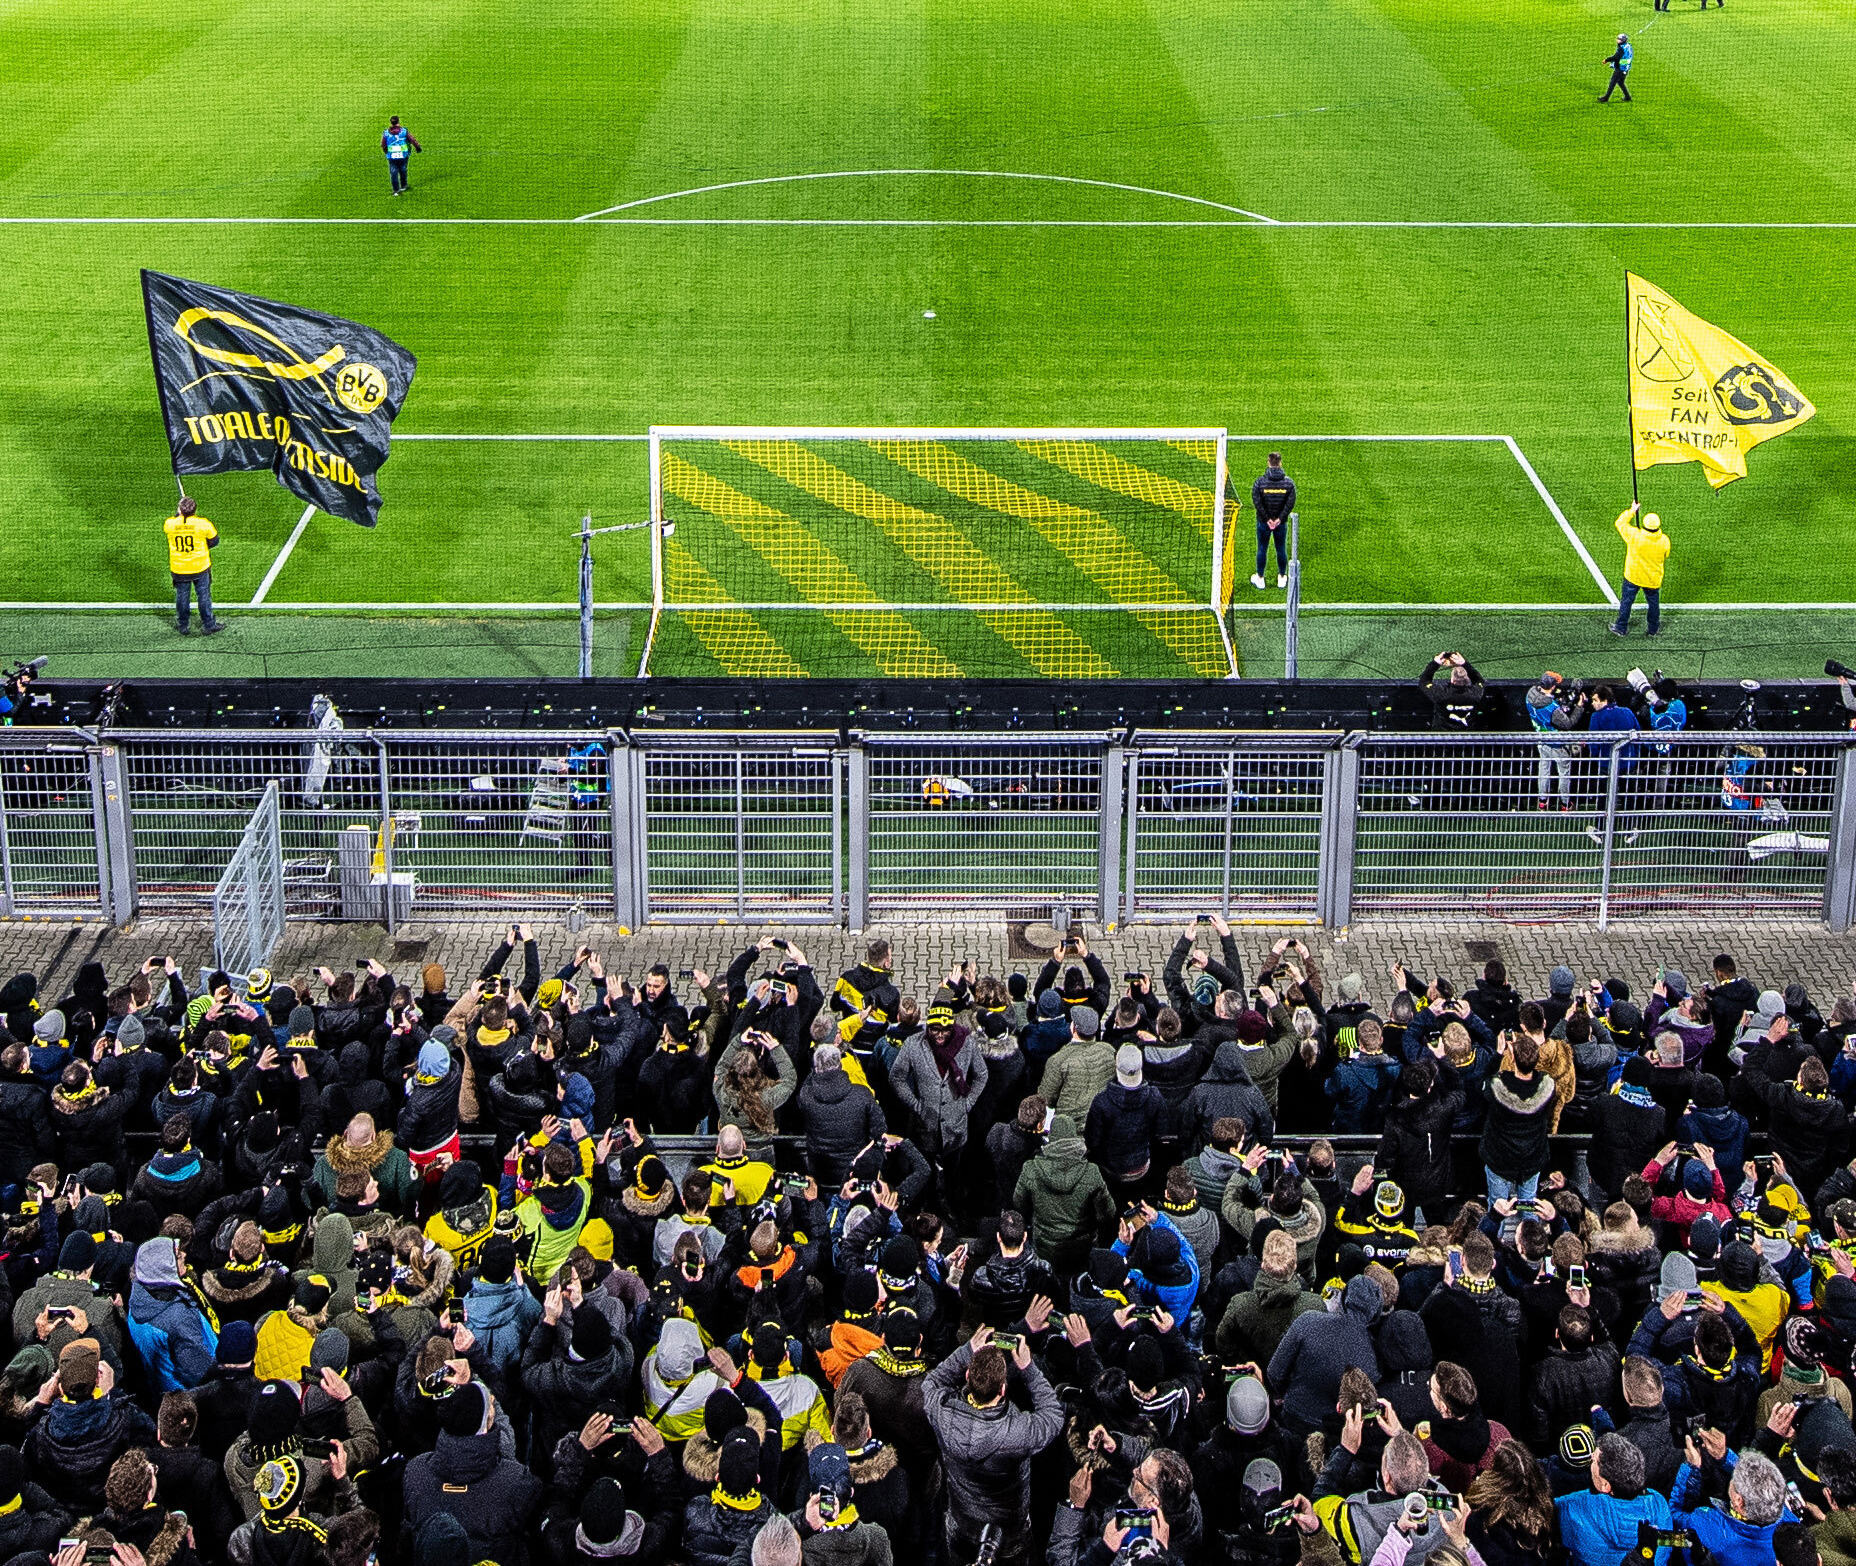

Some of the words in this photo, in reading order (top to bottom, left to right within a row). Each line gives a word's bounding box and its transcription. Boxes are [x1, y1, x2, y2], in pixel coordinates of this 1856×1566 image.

[341, 367, 379, 403] BVB
[1671, 386, 1709, 404] Seit
[1670, 407, 1709, 426] FAN
[174, 534, 195, 554] 09
